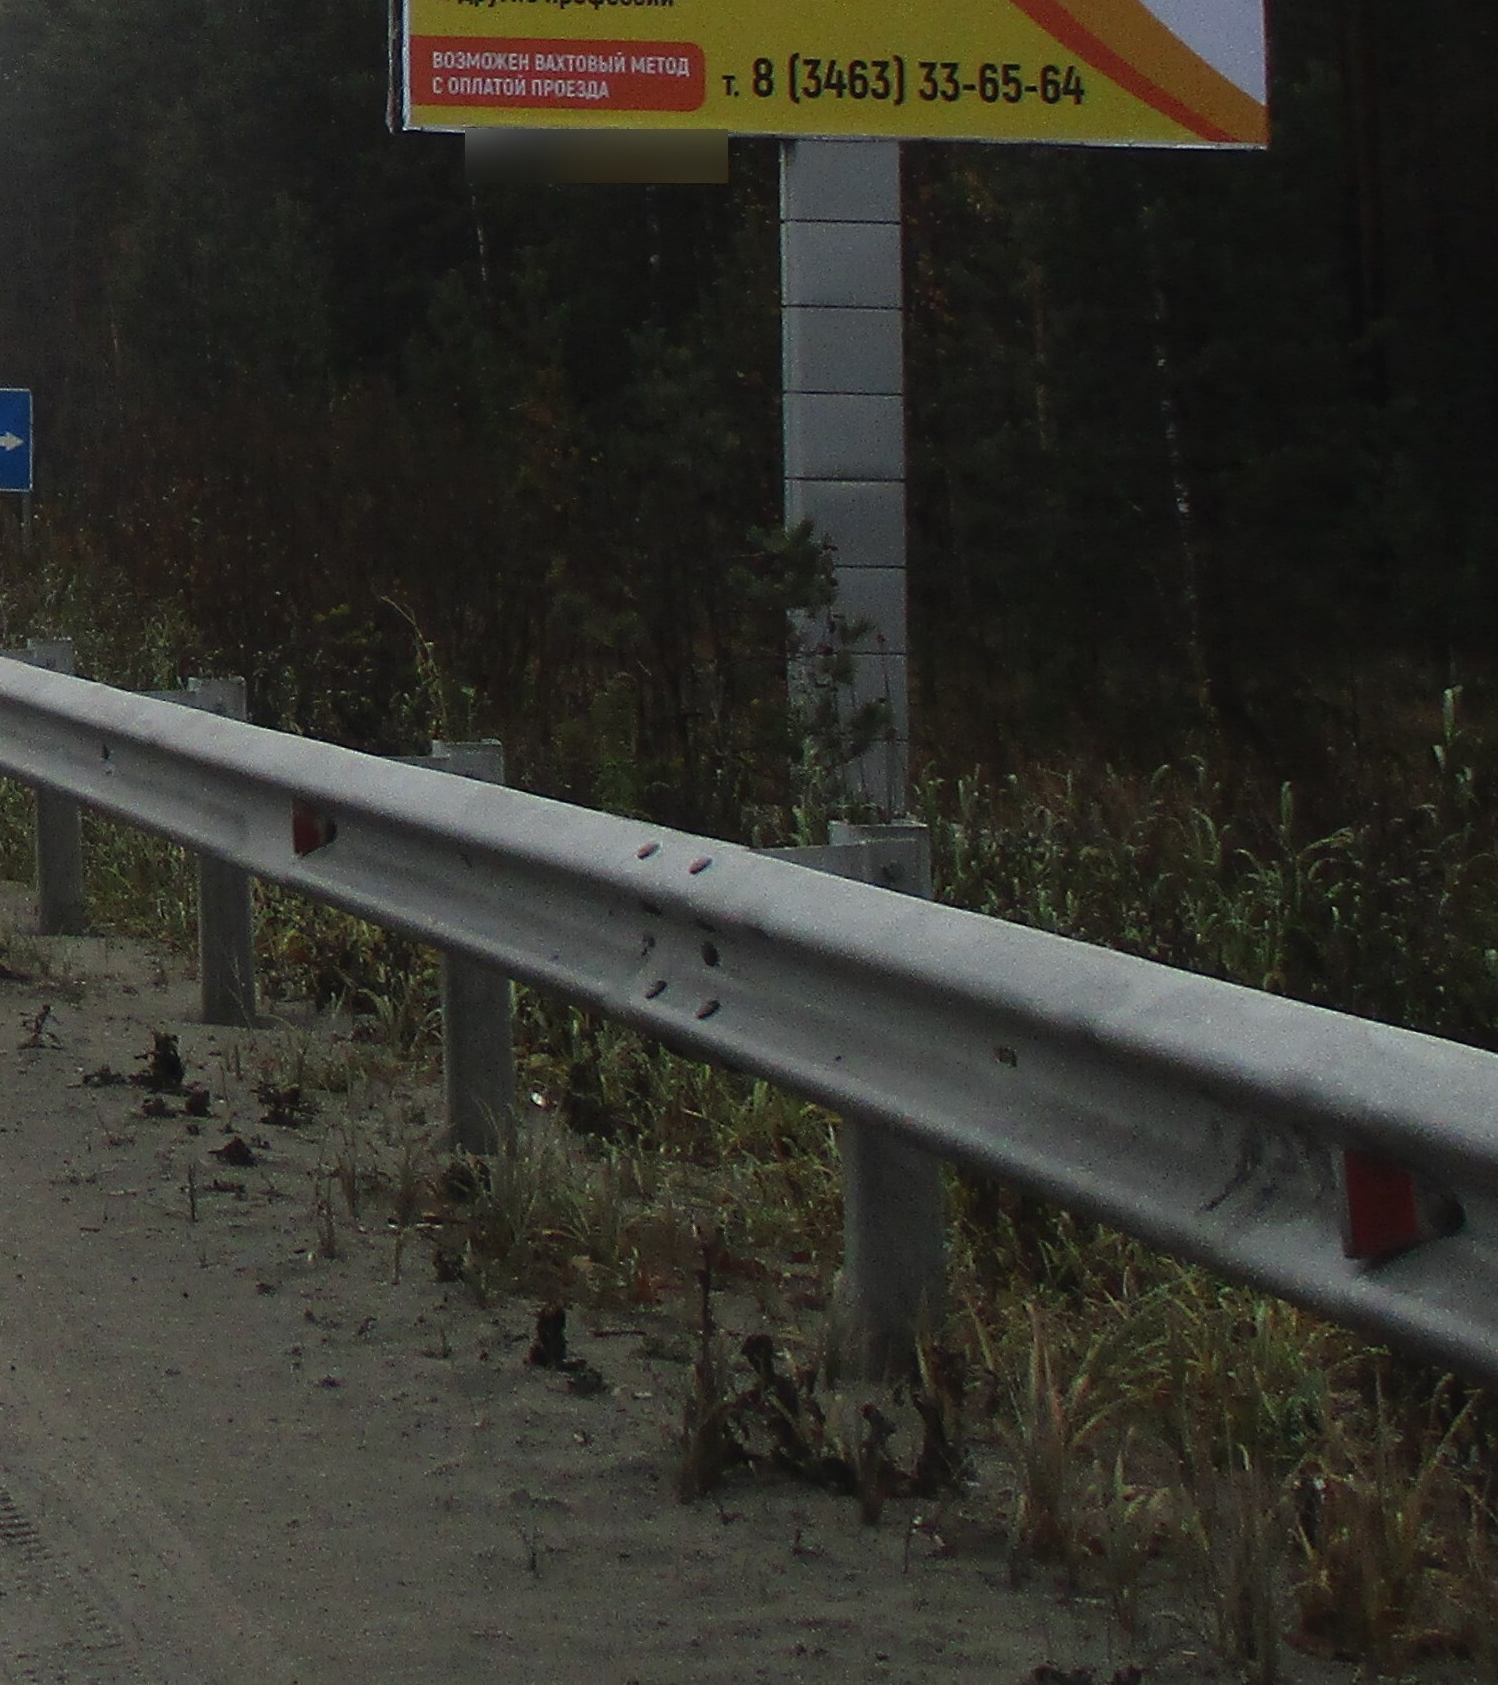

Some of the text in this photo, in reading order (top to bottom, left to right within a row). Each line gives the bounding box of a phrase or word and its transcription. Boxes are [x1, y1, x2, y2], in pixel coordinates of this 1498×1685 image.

[433, 51, 690, 77] ВОЗМОЖЕН ВАХТОВЫЙ МЕТОД
[433, 73, 610, 99] С ОПЛАТОЙ ПРОЕЗДА
[722, 52, 1085, 105] т. 8 (3463) 33-65-64
